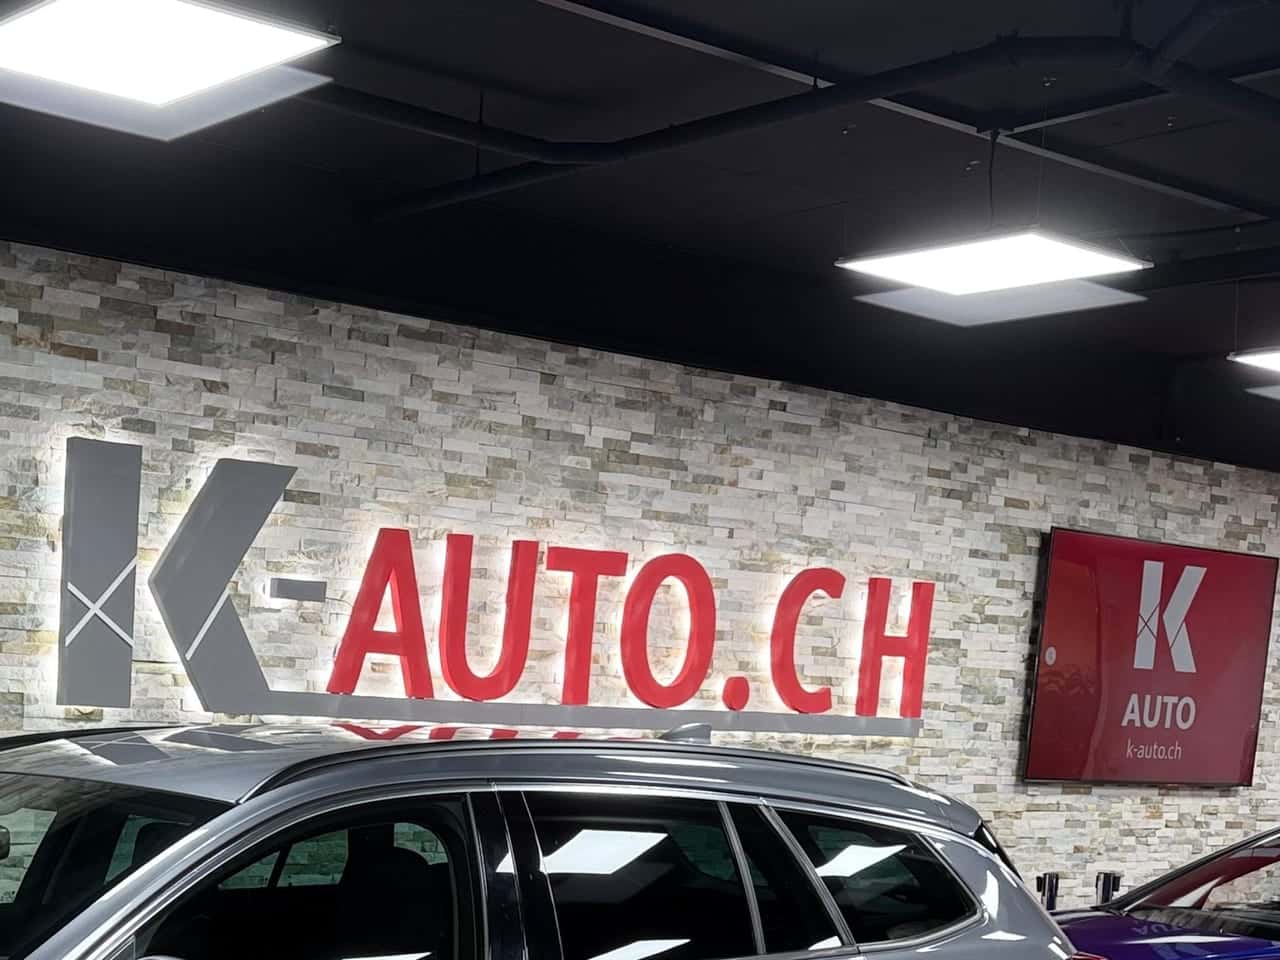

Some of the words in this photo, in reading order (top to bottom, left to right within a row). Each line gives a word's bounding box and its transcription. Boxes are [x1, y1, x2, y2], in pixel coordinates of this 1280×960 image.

[1133, 559, 1208, 673] K
[1120, 693, 1196, 730] AUTO
[1126, 738, 1182, 760] k-auto.ch
